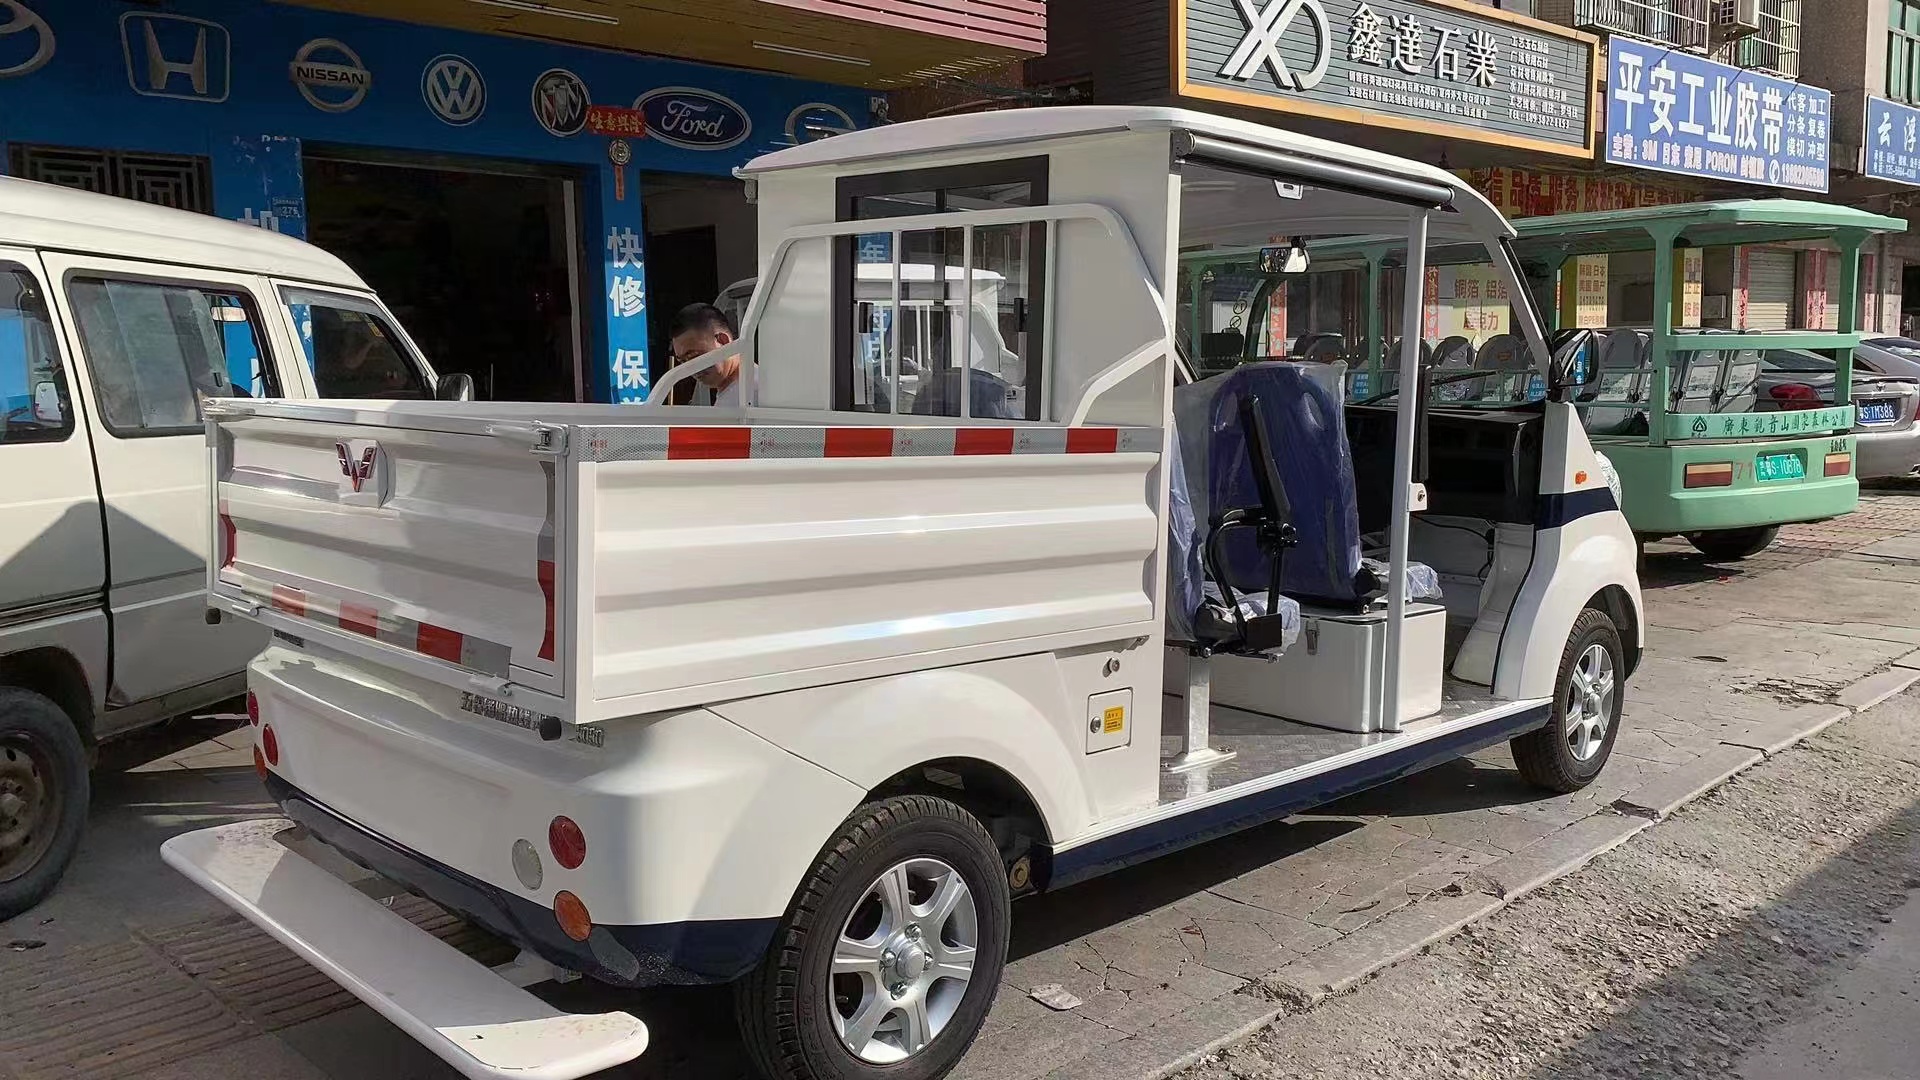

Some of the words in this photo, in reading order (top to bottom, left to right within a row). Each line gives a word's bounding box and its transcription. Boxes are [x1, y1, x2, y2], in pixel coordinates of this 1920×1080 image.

[295, 65, 365, 85] NISSAN
[1614, 51, 1784, 156] 平安工业胶带
[1787, 92, 1806, 112] 代客
[1808, 95, 1826, 116] 加工
[660, 100, 726, 139] Ford
[1787, 115, 1806, 135] 分条
[1808, 118, 1826, 140] 复卷
[1705, 149, 1737, 175] PORON
[1786, 138, 1805, 157] 模切
[1807, 141, 1825, 162] 冲型
[1455, 279, 1480, 299] 铜箔
